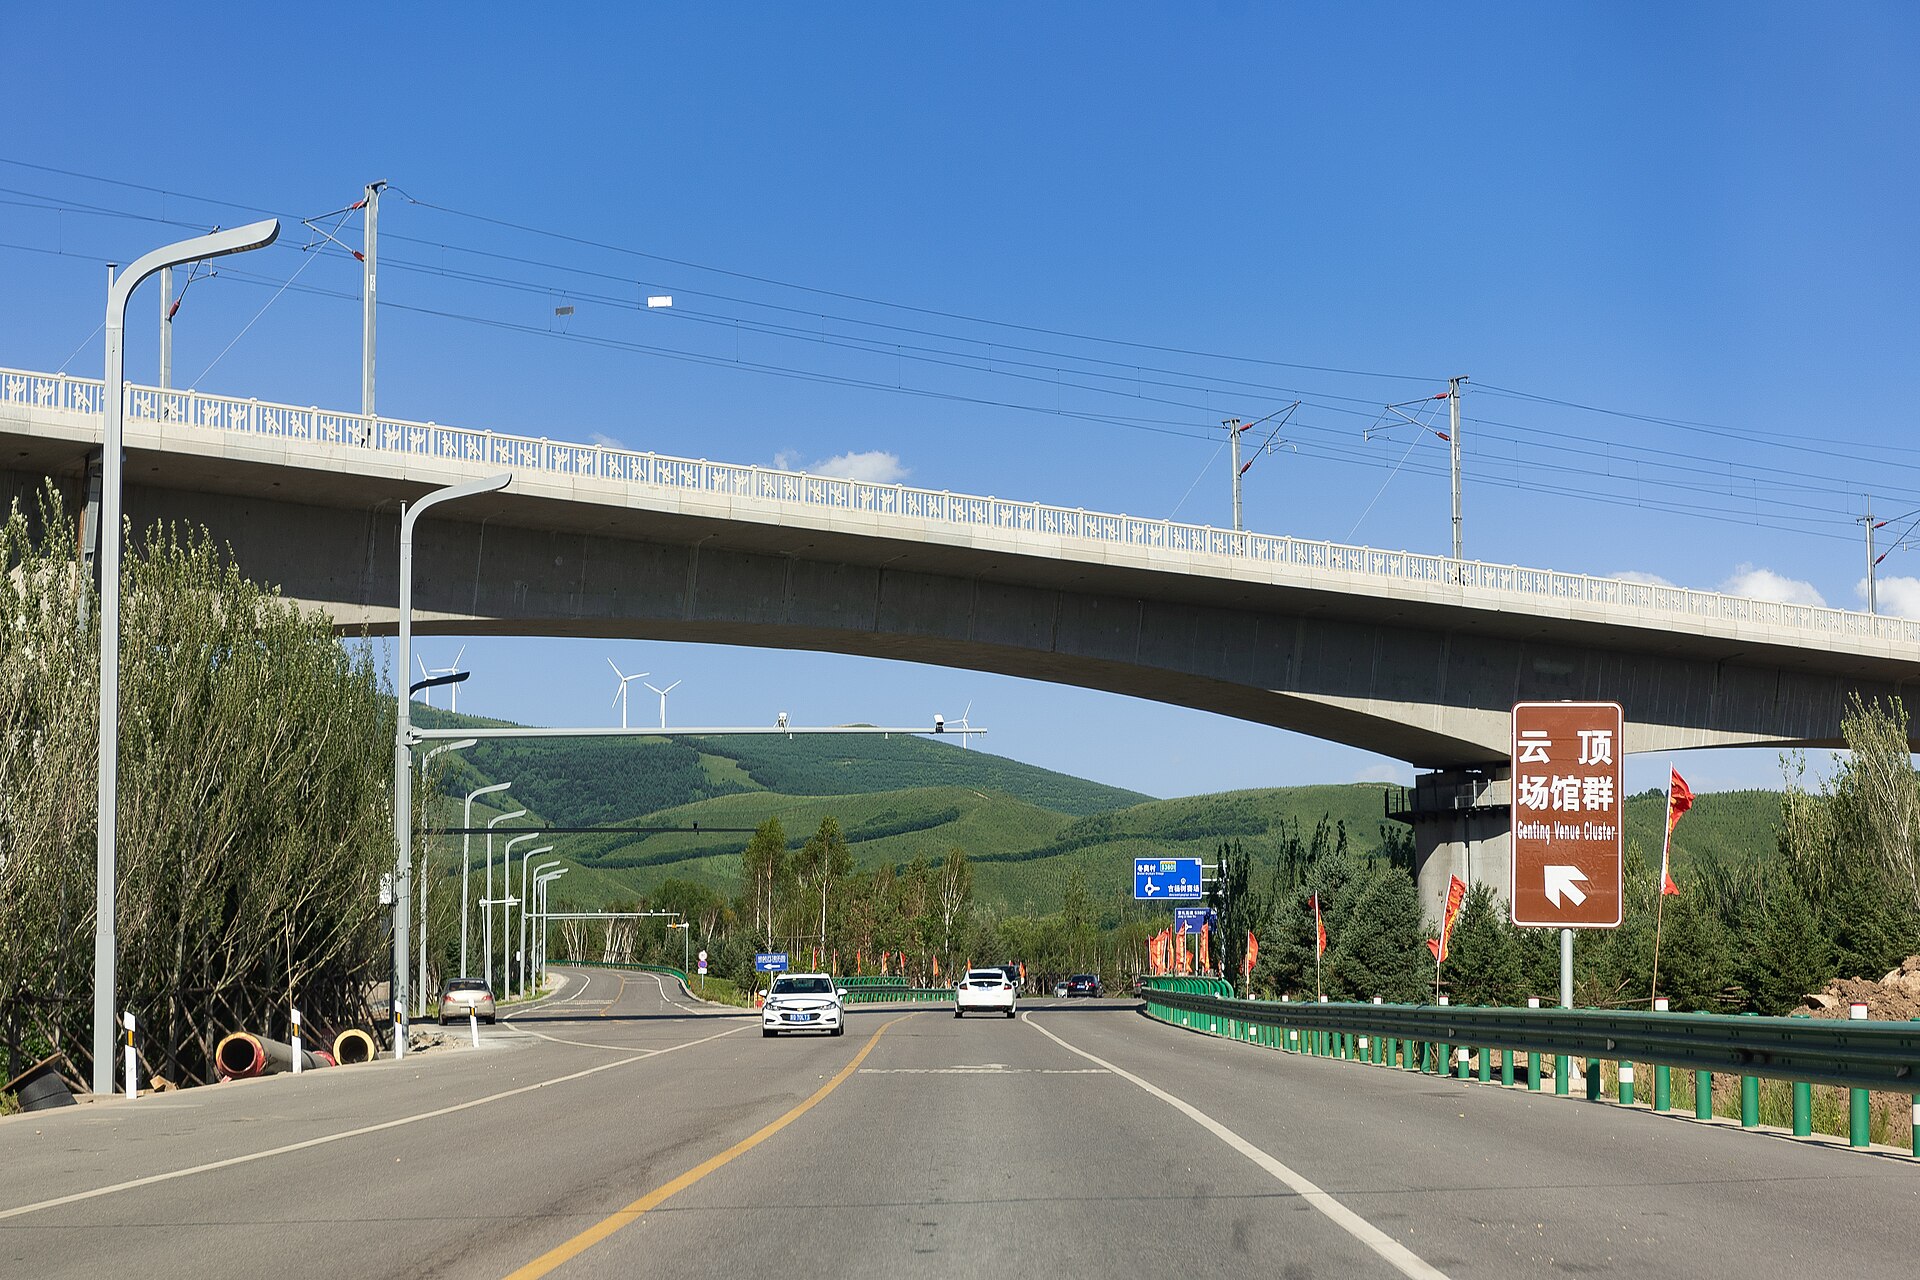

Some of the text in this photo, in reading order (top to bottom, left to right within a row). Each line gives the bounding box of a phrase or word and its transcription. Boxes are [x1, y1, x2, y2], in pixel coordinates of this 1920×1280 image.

[1517, 730, 1613, 766] 云顶
[1517, 775, 1614, 812] 场馆群
[1517, 820, 1616, 846] Genting Venue Cluster
